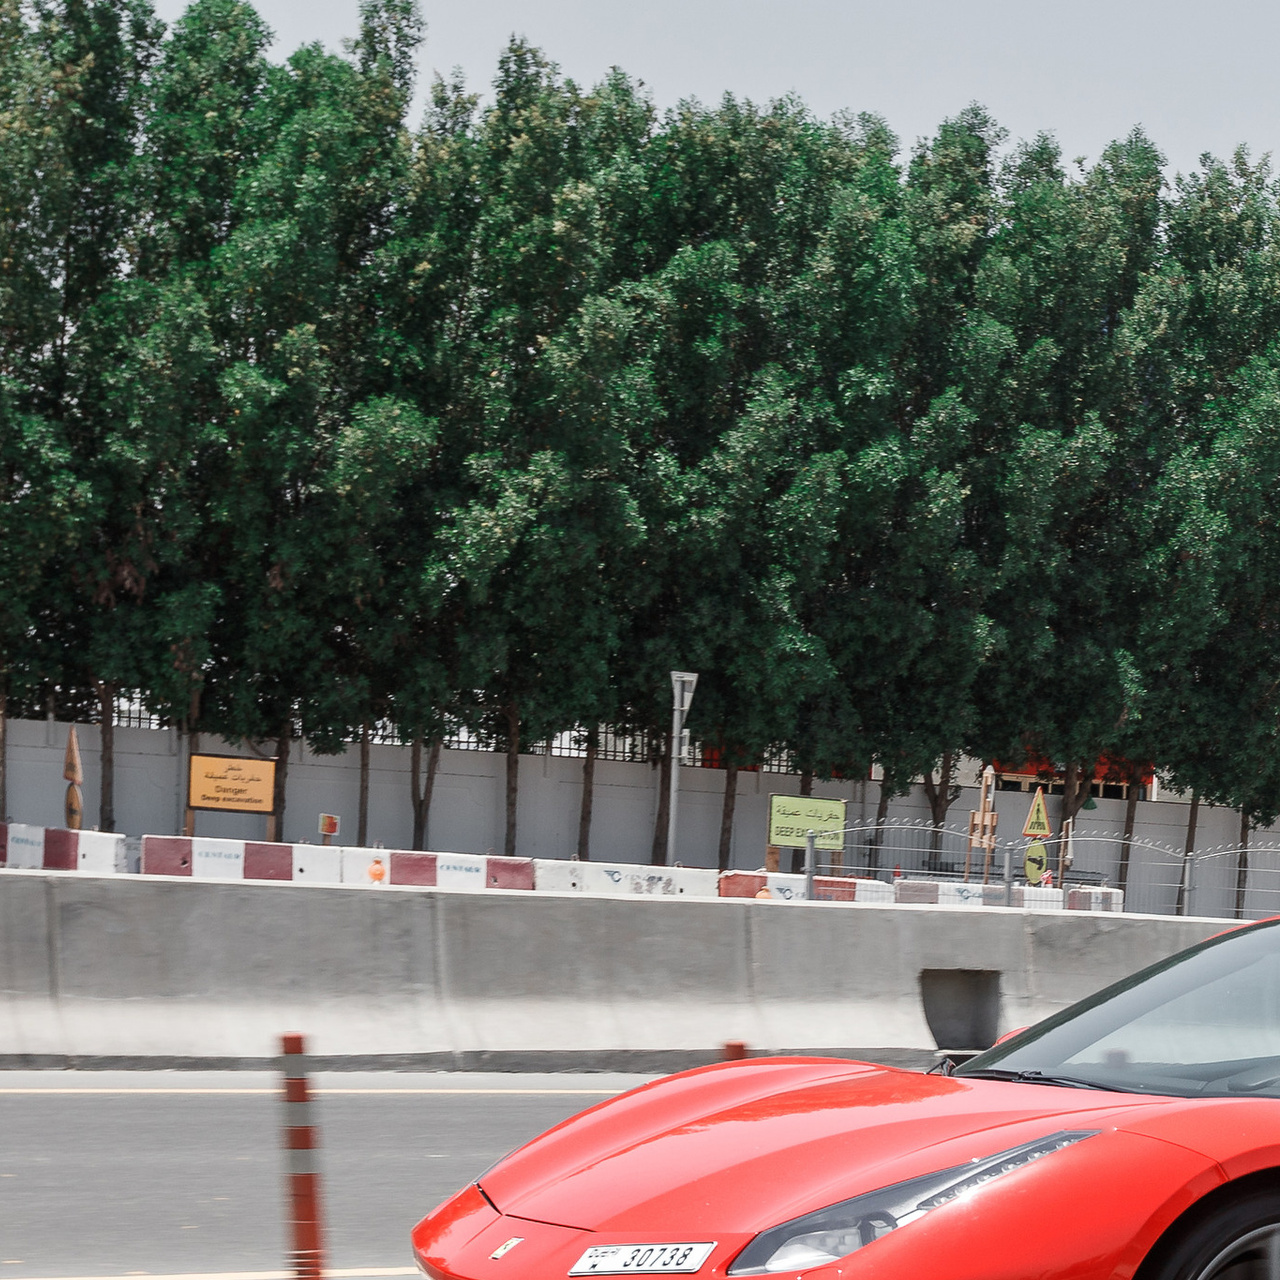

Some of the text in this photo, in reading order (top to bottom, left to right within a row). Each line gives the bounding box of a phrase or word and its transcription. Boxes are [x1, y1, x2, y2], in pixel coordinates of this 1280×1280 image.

[214, 785, 248, 796] Danger
[776, 804, 840, 822] حفريات عميقة
[775, 825, 794, 837] DEEP
[622, 1246, 694, 1268] 30738
